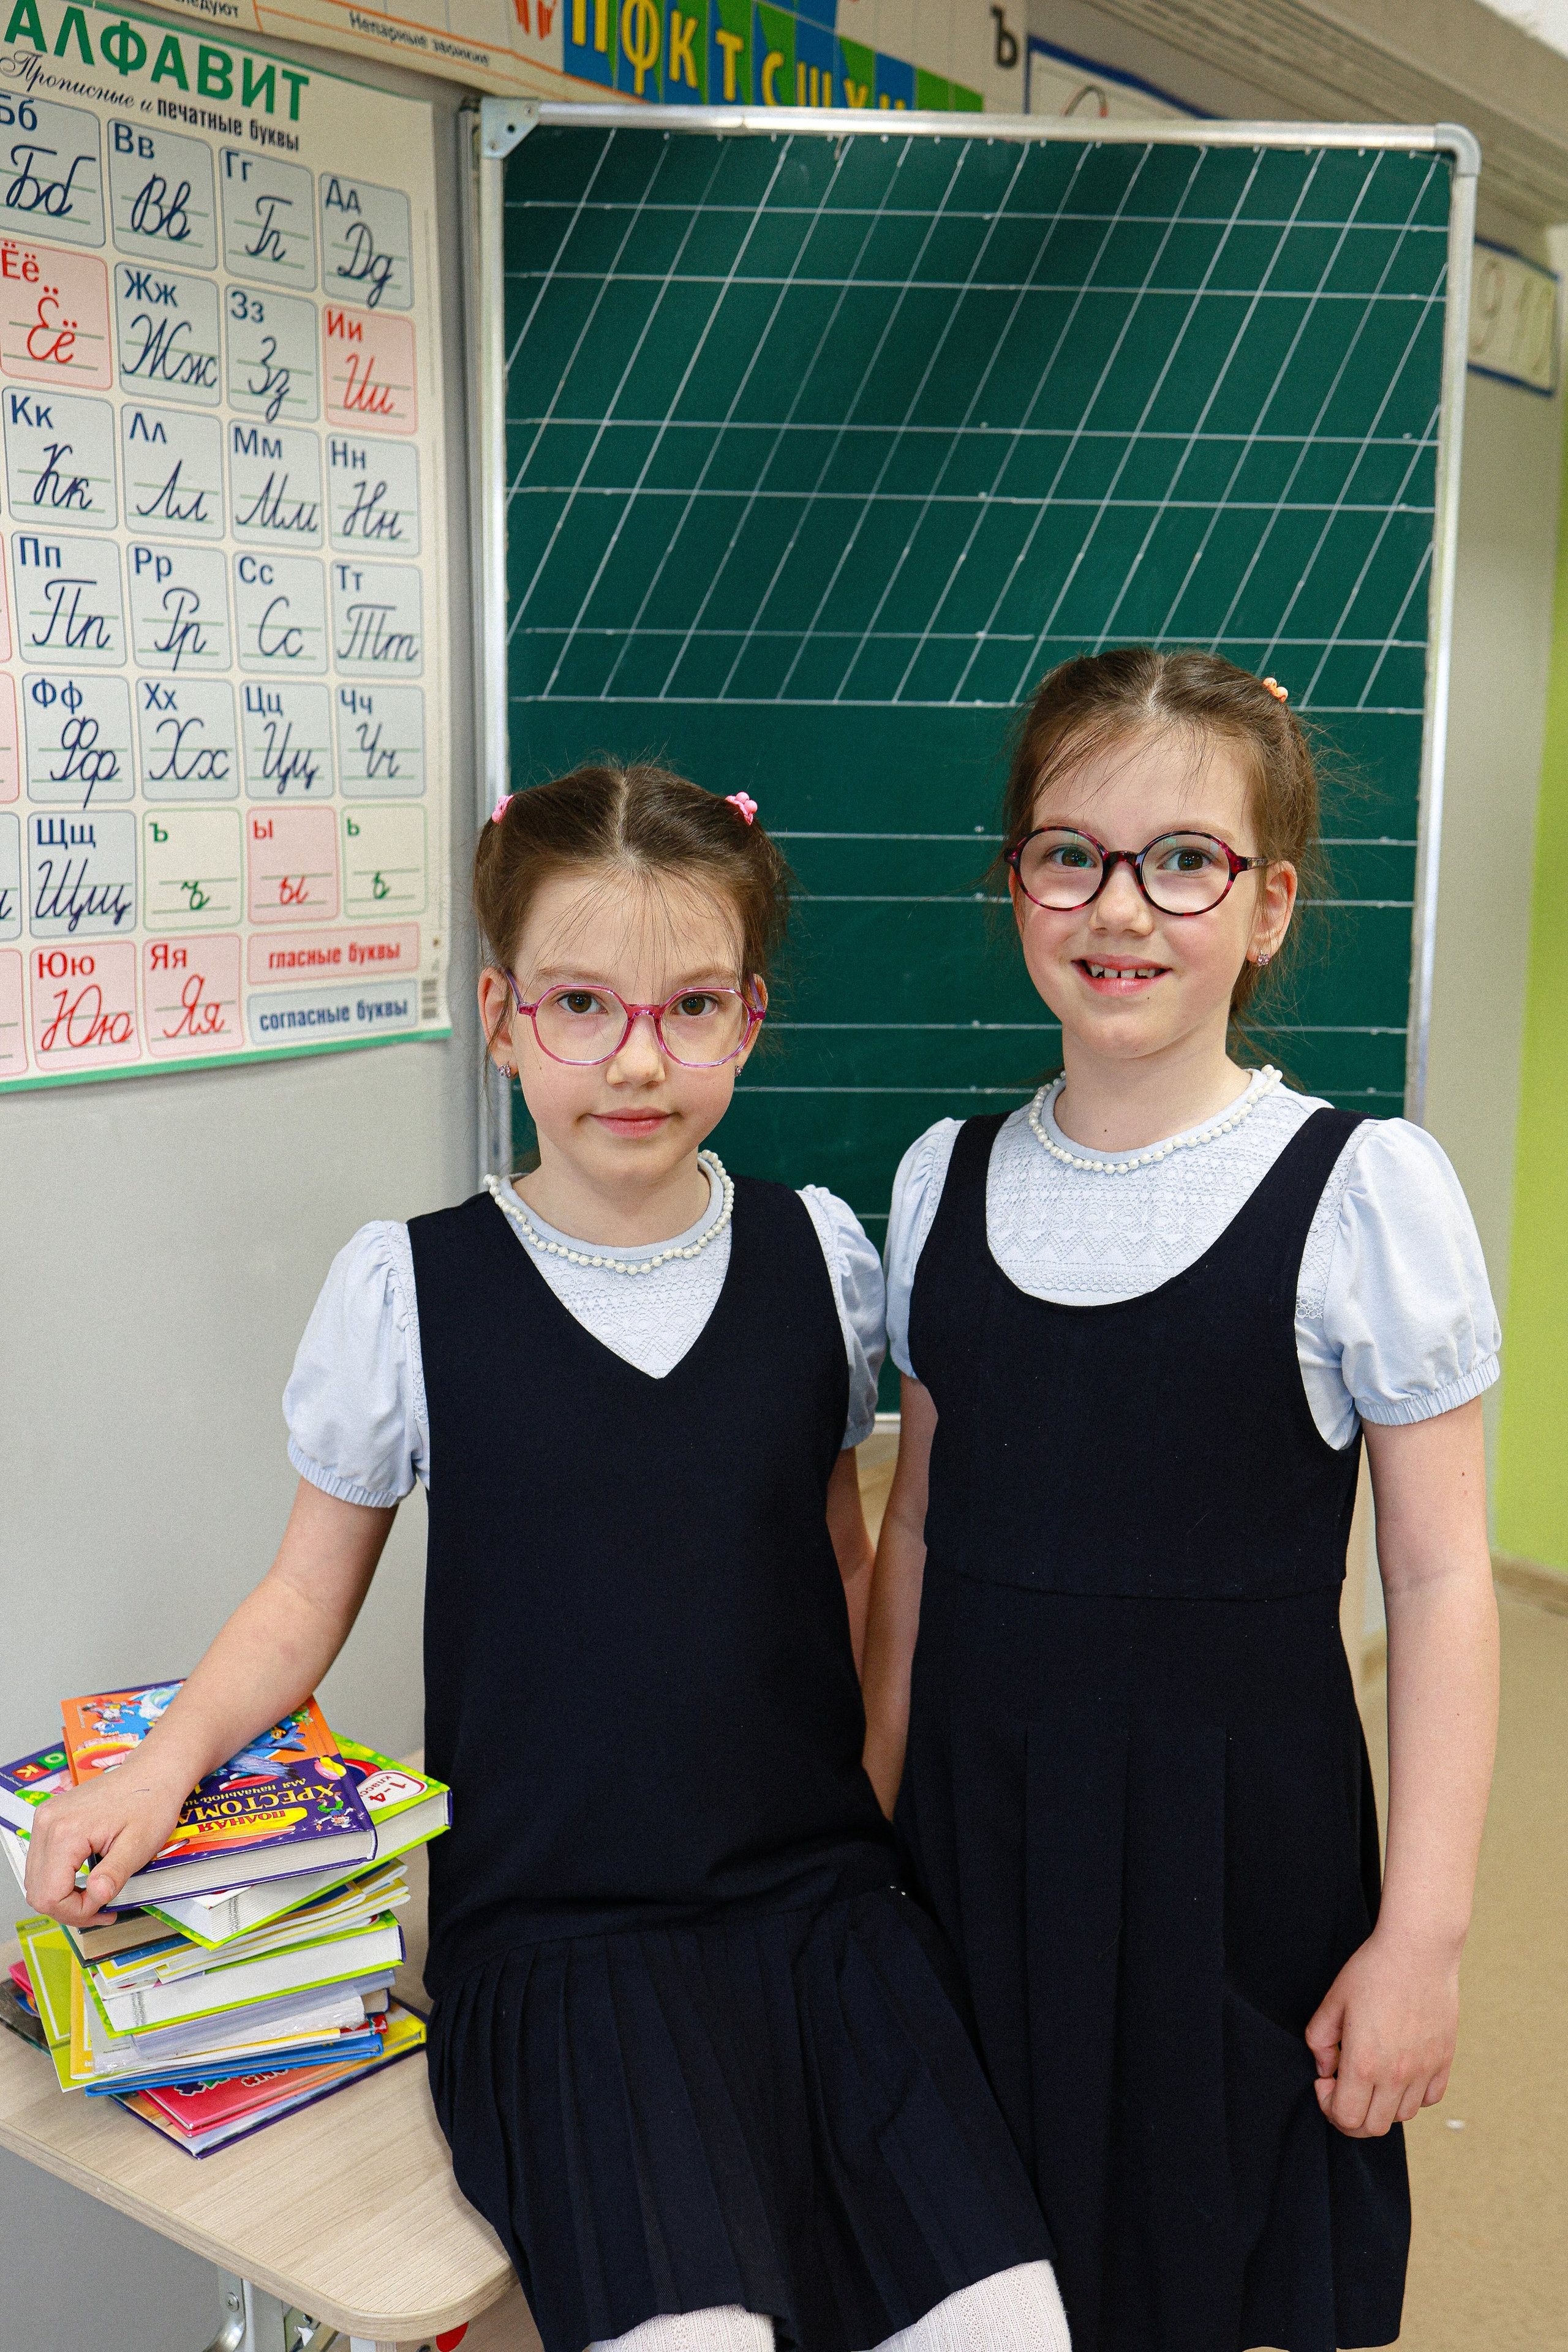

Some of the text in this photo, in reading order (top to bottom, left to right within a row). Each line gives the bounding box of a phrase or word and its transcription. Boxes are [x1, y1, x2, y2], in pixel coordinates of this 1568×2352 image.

[4, 0, 309, 121] АЛФАВИТ
[621, 0, 660, 95] Ф
[669, 9, 698, 88] К
[715, 28, 744, 102] Т
[0, 50, 299, 153] Прописные и печатные буквы
[0, 93, 37, 131] Бб
[115, 123, 155, 159] Вв
[225, 150, 253, 182] Гг
[325, 178, 362, 214] Дд
[1, 242, 39, 282] Ёё
[124, 270, 177, 307] Жж
[230, 291, 264, 323] Зз
[328, 310, 363, 341] Ии
[11, 394, 53, 429] Кк
[130, 412, 166, 443] Лл
[234, 428, 282, 458] Мм
[331, 440, 366, 469] Нн
[20, 537, 61, 568] Пп
[134, 548, 172, 582] Рр
[239, 556, 274, 585] Сс
[337, 564, 363, 591] Тт
[32, 678, 82, 714] Фф
[145, 682, 177, 710] Хх
[247, 686, 283, 718] Цц
[341, 689, 372, 714] Чч
[37, 819, 96, 850] Щщ
[39, 952, 95, 978] Юю
[151, 943, 187, 970] Яя
[269, 942, 401, 969] гласные буквы
[260, 1000, 408, 1031] согласные буквы
[201, 1784, 276, 1803] начальной
[282, 1777, 306, 1789] для
[360, 1775, 392, 1797] класс
[197, 1811, 285, 1833] ПОЛНАЯ
